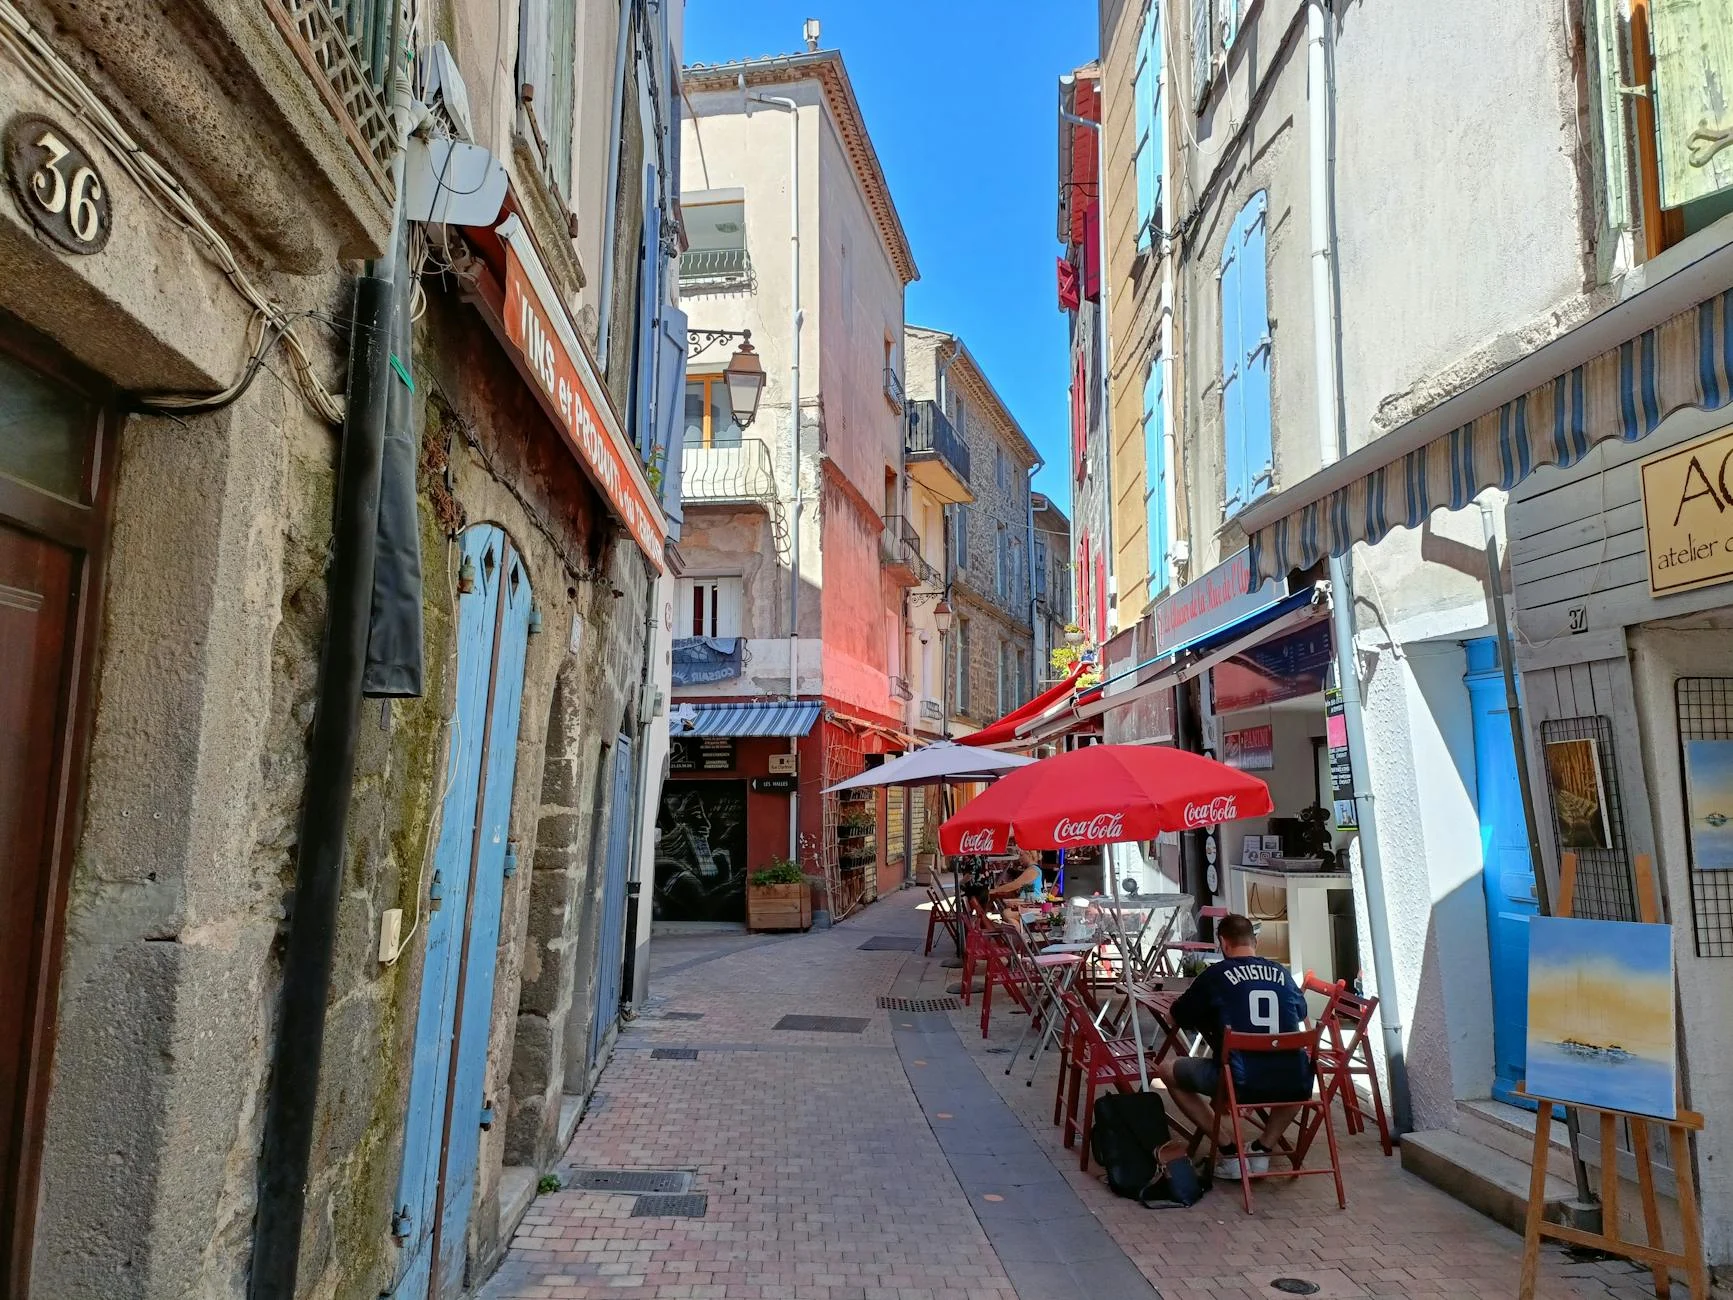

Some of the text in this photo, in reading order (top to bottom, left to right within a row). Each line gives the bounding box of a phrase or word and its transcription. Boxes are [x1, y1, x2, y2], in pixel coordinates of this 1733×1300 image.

[33, 131, 101, 242] 36
[559, 376, 573, 426] et
[623, 485, 635, 526] du
[1673, 447, 1733, 527] A
[1657, 533, 1719, 570] atelier
[1568, 608, 1585, 630] 37
[1224, 964, 1285, 986] BATISTUTA
[1249, 989, 1280, 1034] 9
